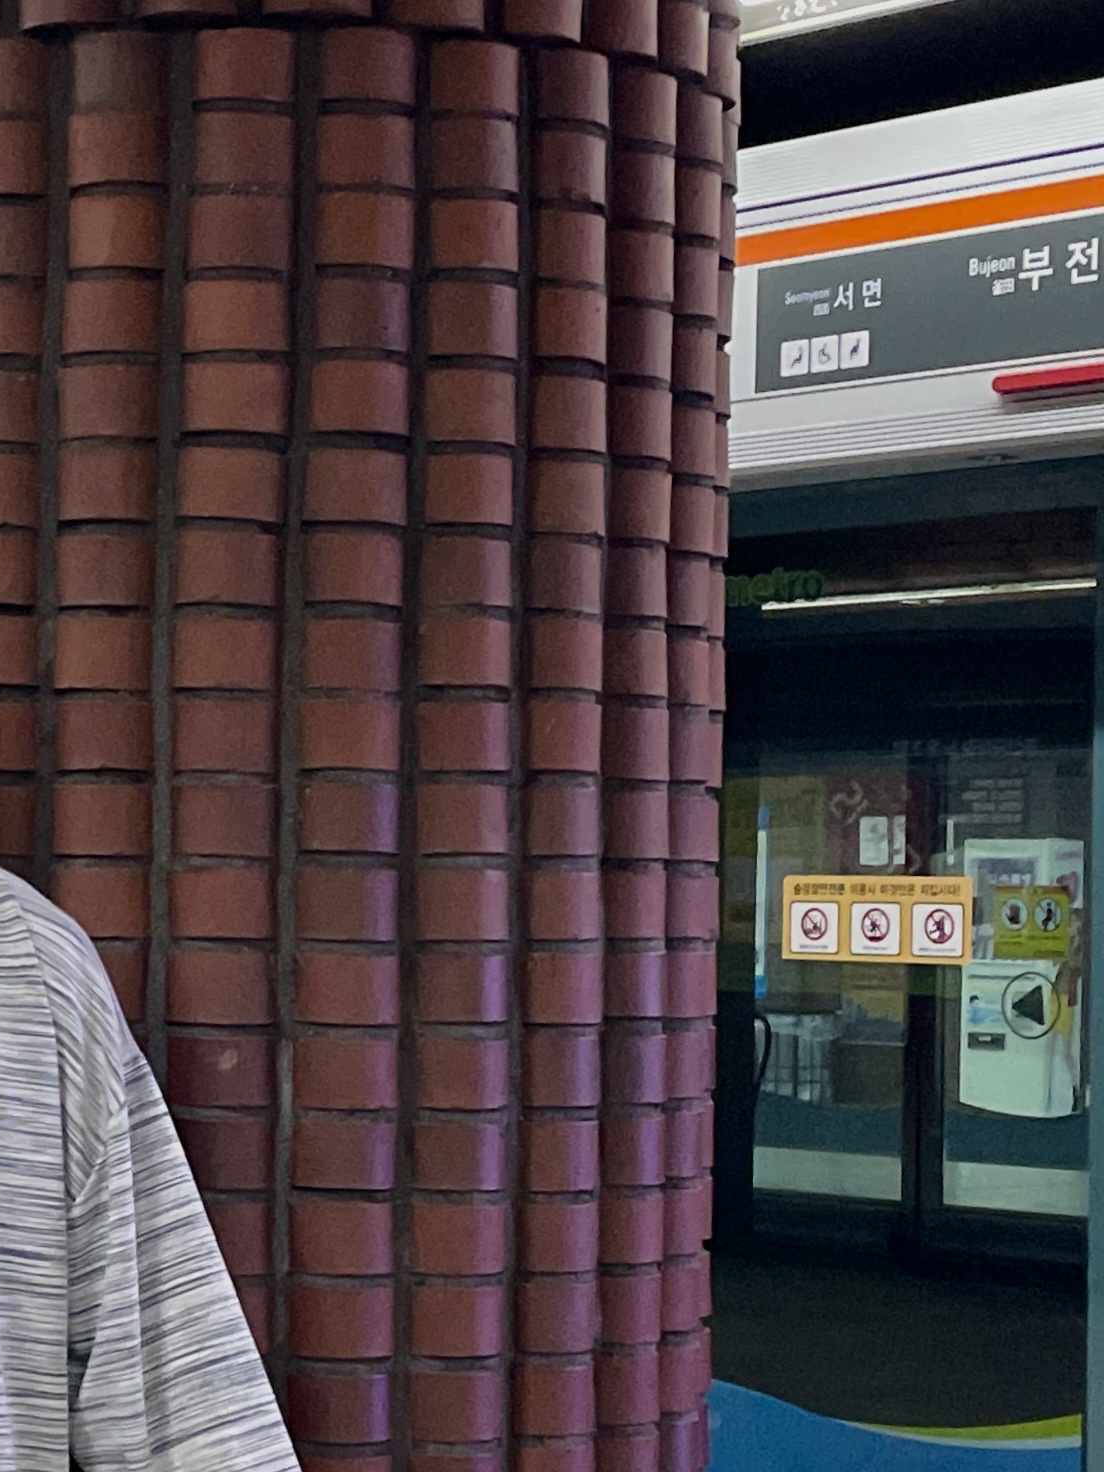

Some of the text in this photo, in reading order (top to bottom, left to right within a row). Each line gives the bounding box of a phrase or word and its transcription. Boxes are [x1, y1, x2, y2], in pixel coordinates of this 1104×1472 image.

[968, 256, 1016, 278] Bujeon
[1018, 237, 1099, 292] 부전
[833, 277, 882, 311] 서면
